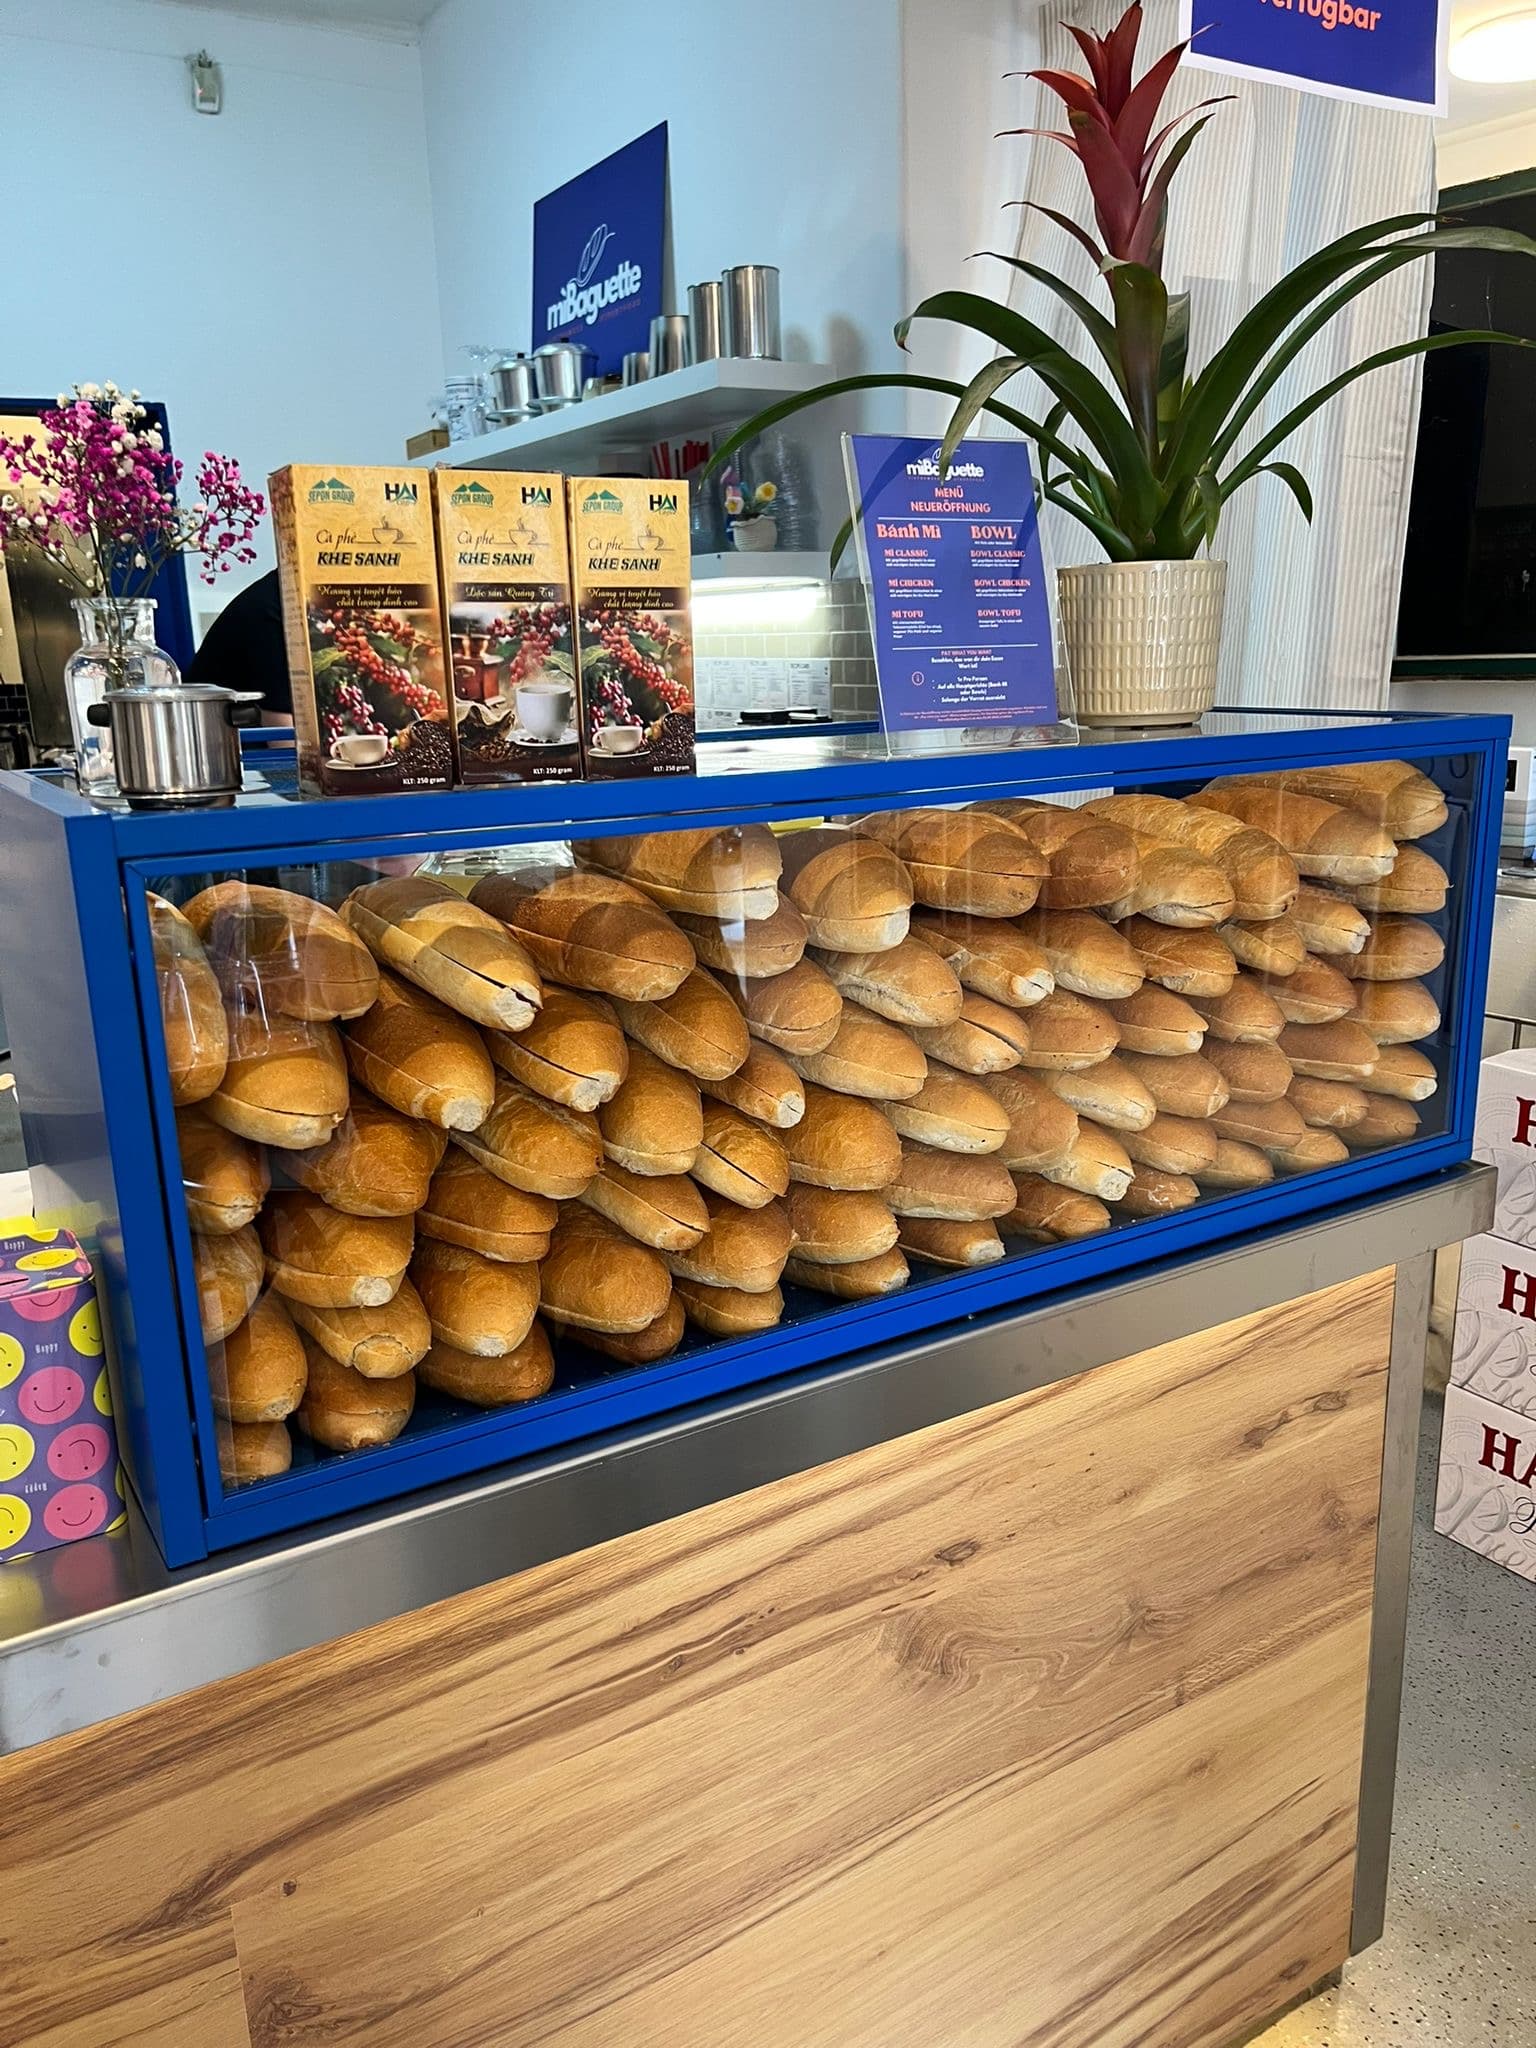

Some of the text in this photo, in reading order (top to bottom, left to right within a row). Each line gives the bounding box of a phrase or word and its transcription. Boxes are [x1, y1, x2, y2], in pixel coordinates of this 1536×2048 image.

[331, 489, 355, 503] GROUP
[934, 485, 964, 498] MENÜ
[910, 499, 991, 513] NEUERÖFFNUNG
[876, 523, 920, 538] Bánh
[971, 525, 1017, 539] BOWL
[317, 552, 401, 566] KHE SANH
[458, 551, 535, 566] KHE SANH
[895, 549, 929, 558] CLASSIC
[970, 550, 1026, 558] BOWL CLASSIC
[588, 558, 661, 571] KHE SANH
[902, 610, 924, 618] TOFU
[1000, 609, 1021, 617] TOFU
[417, 777, 429, 785] 250
